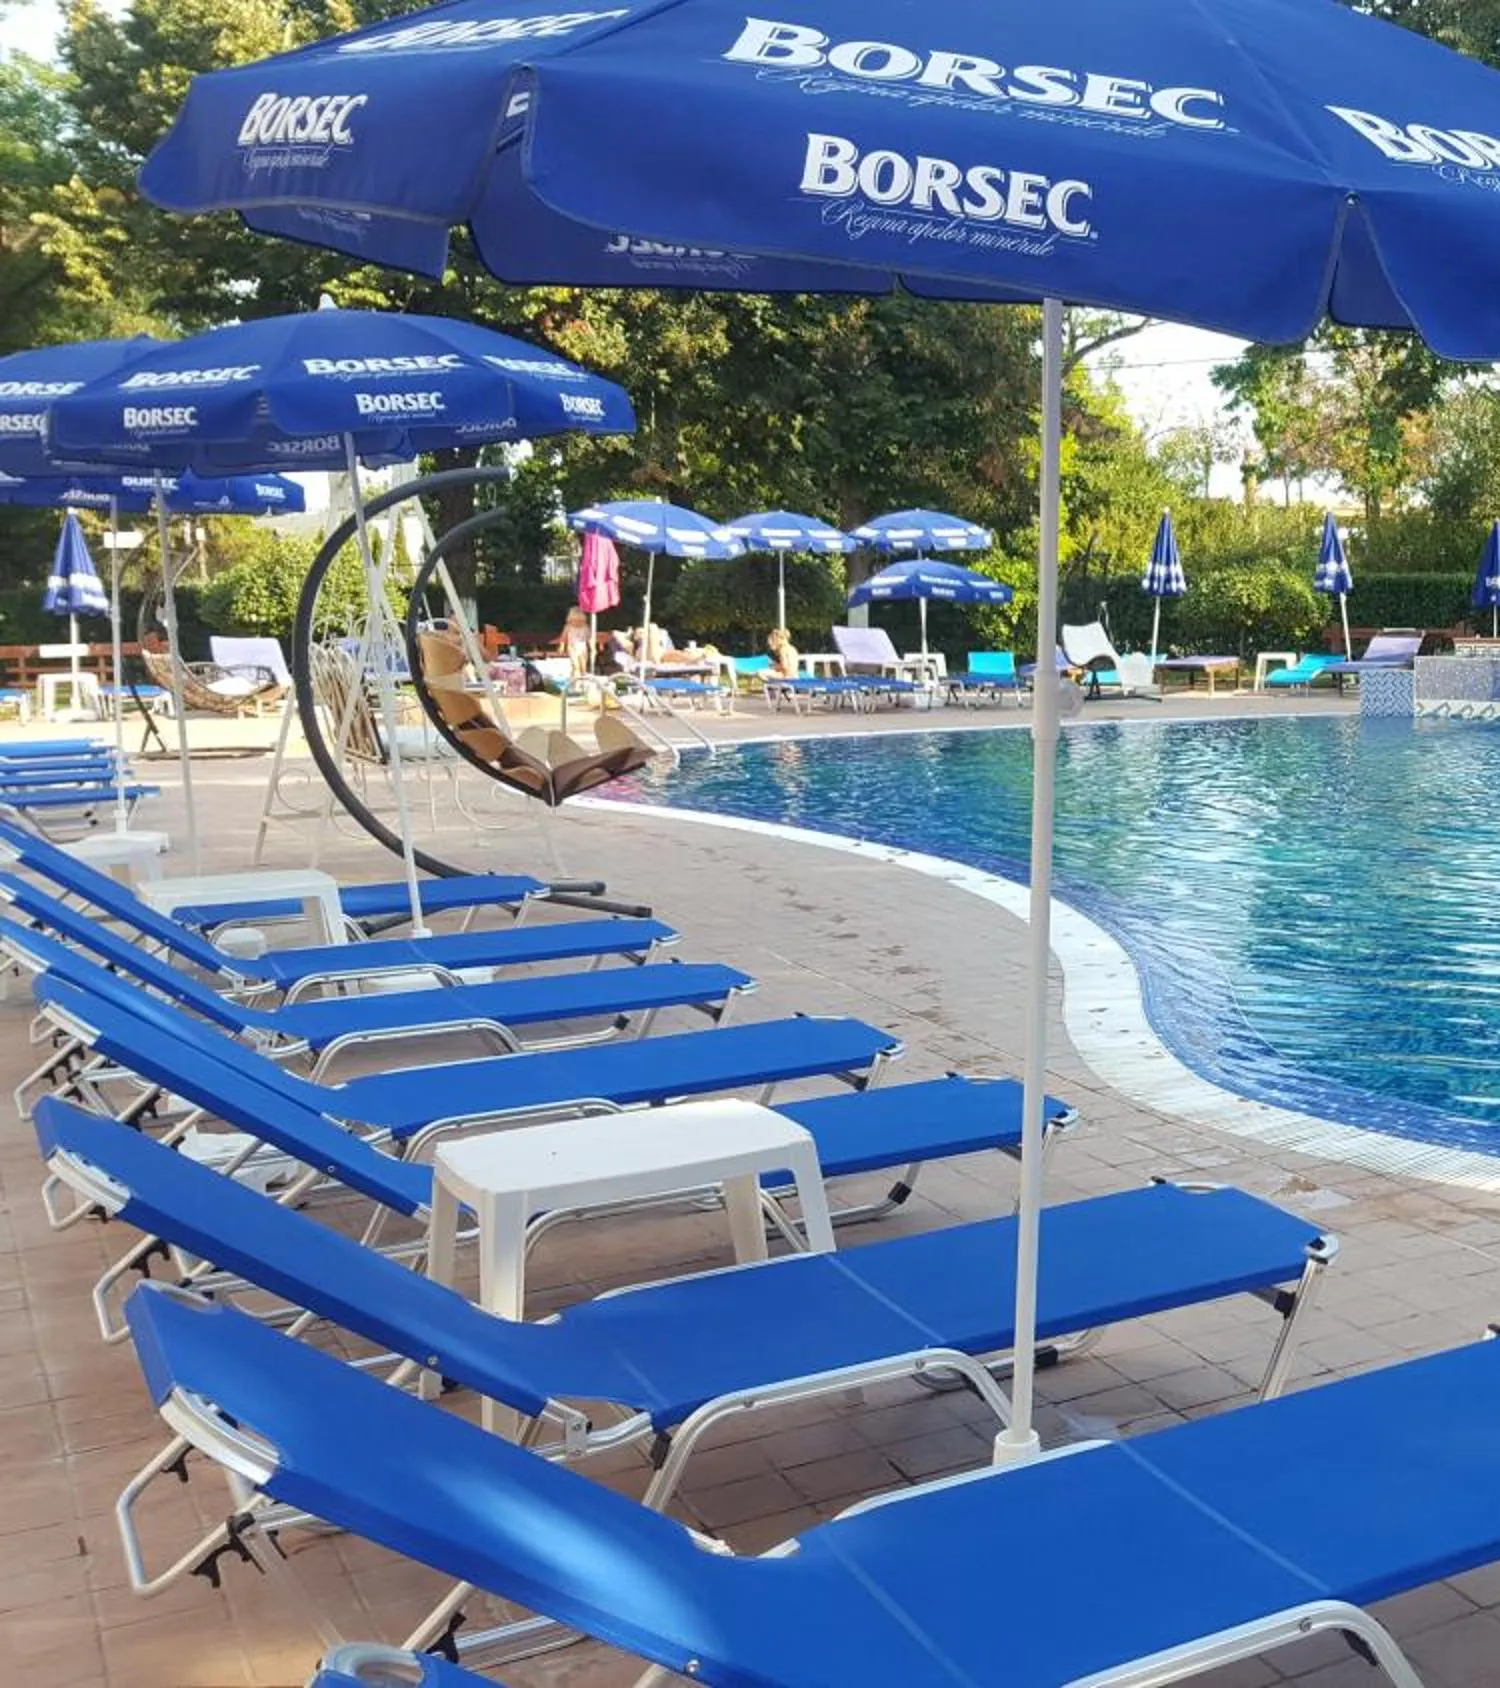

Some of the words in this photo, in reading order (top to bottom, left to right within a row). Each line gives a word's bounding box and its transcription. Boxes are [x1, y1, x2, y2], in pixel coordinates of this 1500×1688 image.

[721, 17, 1228, 130] BORSEC
[237, 92, 368, 147] BORSEC
[799, 132, 1094, 238] BORSEC
[821, 199, 908, 241] Regina
[907, 214, 967, 244] apelor
[968, 231, 1061, 257] minerale
[302, 354, 466, 376] BORSEC
[0, 413, 48, 431] RSEC
[123, 405, 199, 429] BORSEC
[355, 391, 446, 415] BORSEC
